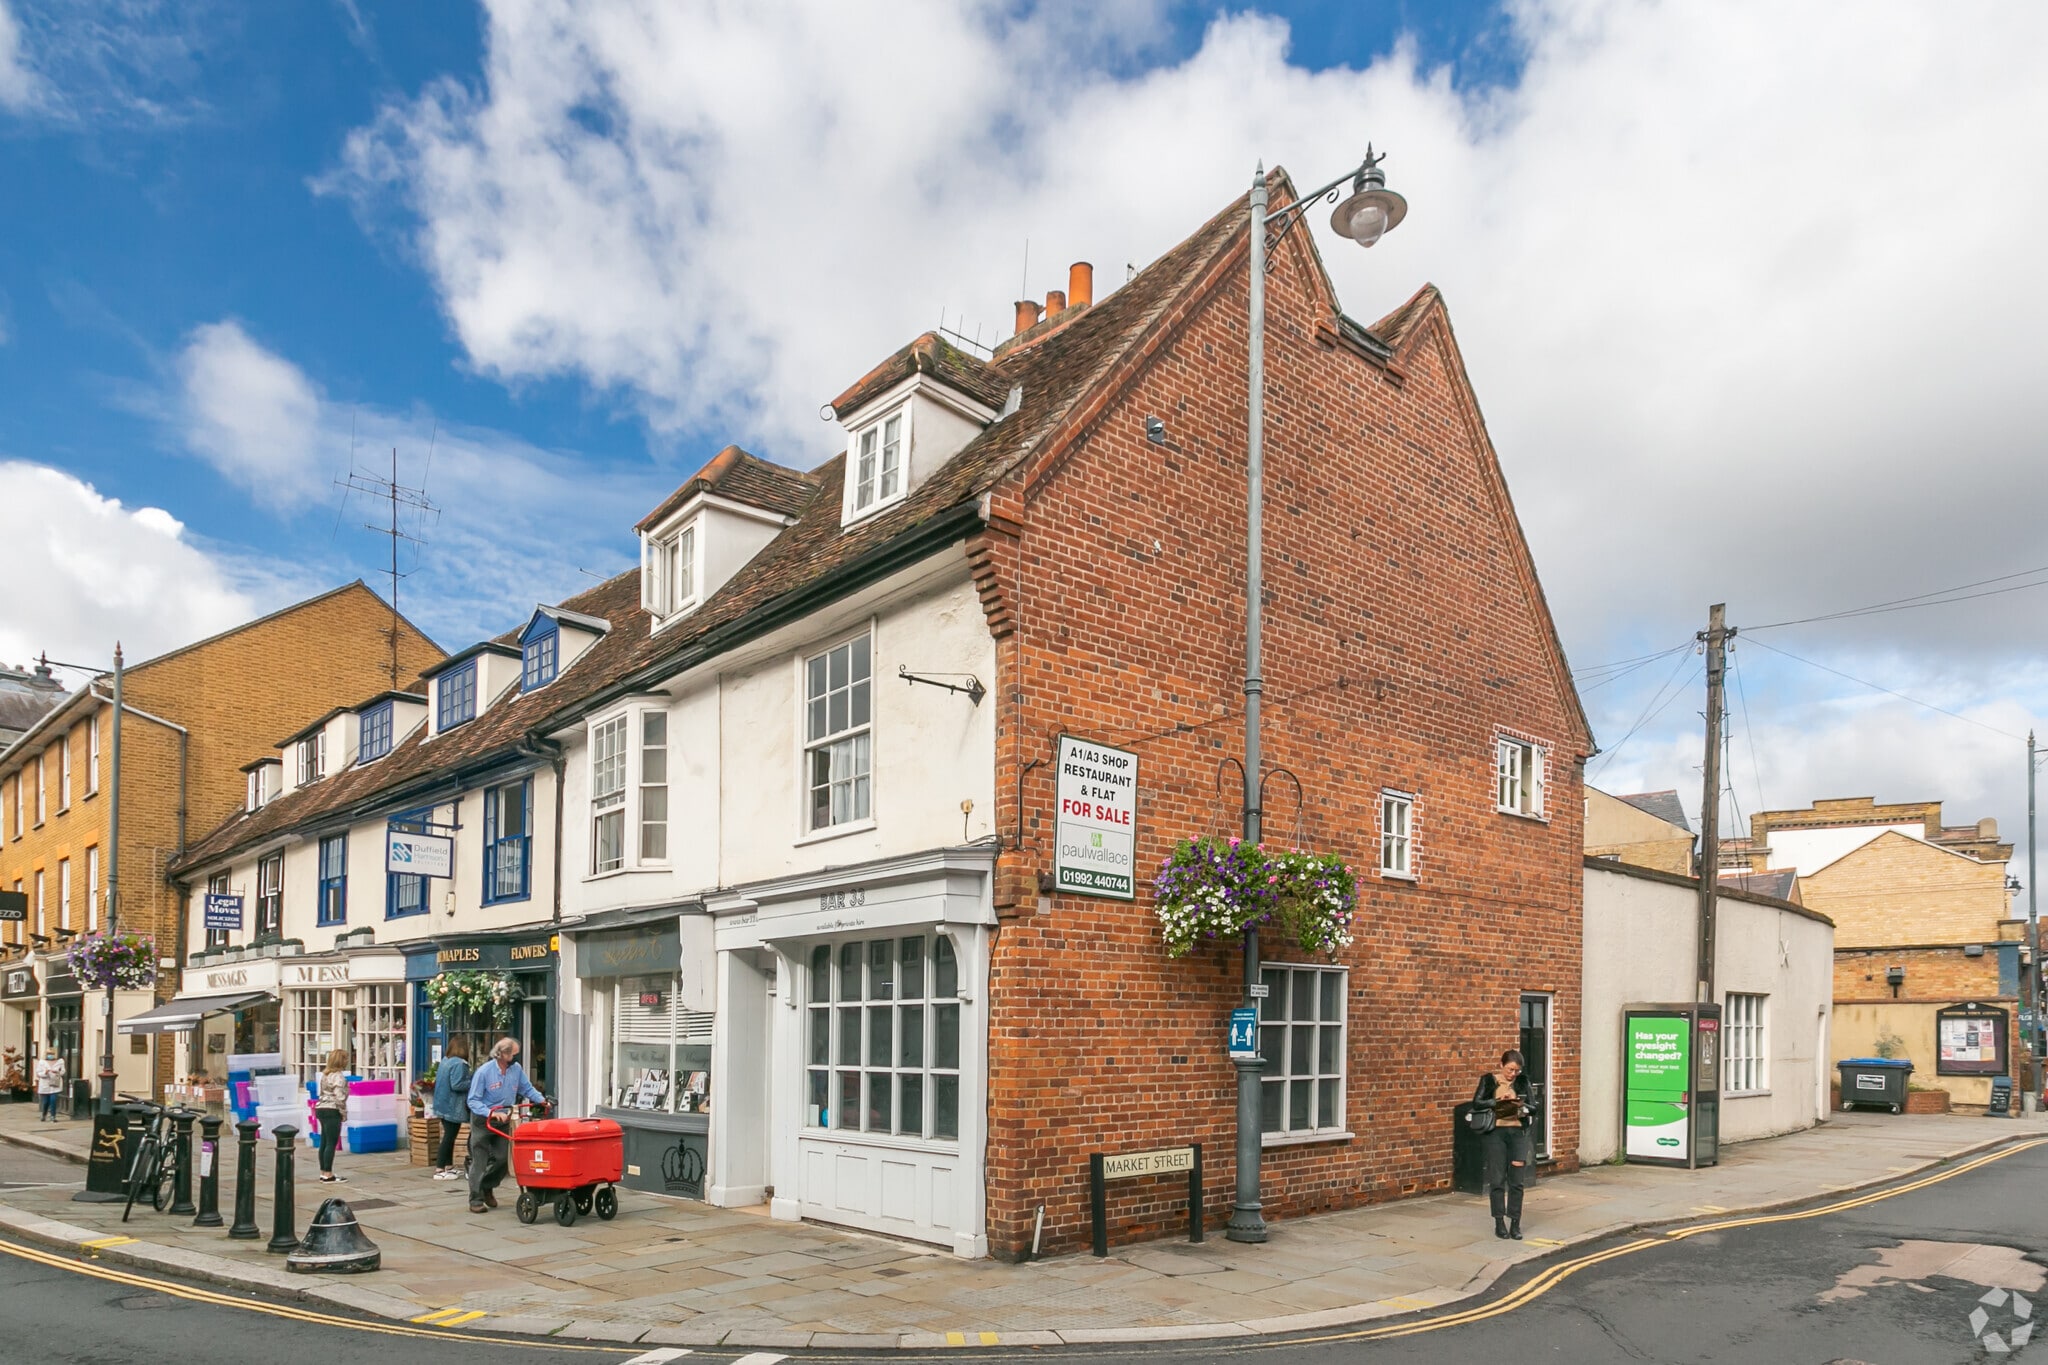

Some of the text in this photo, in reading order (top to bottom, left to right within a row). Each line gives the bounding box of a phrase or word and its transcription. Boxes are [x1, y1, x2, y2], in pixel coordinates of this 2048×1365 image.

[1070, 746, 1129, 770] A1/A3 SHOP
[1064, 763, 1132, 788] RESTAURANT
[1080, 784, 1116, 802] & FLAT
[1063, 799, 1130, 825] FOR SALE
[414, 844, 448, 855] Duffield
[1062, 844, 1129, 866] paulwallace
[1062, 871, 1128, 890] 01992 440744
[210, 896, 238, 907] Legal
[820, 887, 866, 911] BAR 33
[208, 904, 240, 914] Moves
[511, 944, 548, 960] FLOWERS
[206, 969, 248, 988] MESSAGES
[1635, 1032, 1679, 1044] Has your
[1635, 1042, 1677, 1051] eyesight
[1635, 1051, 1682, 1061] changed?
[1106, 1153, 1190, 1174] MARKET STREET
